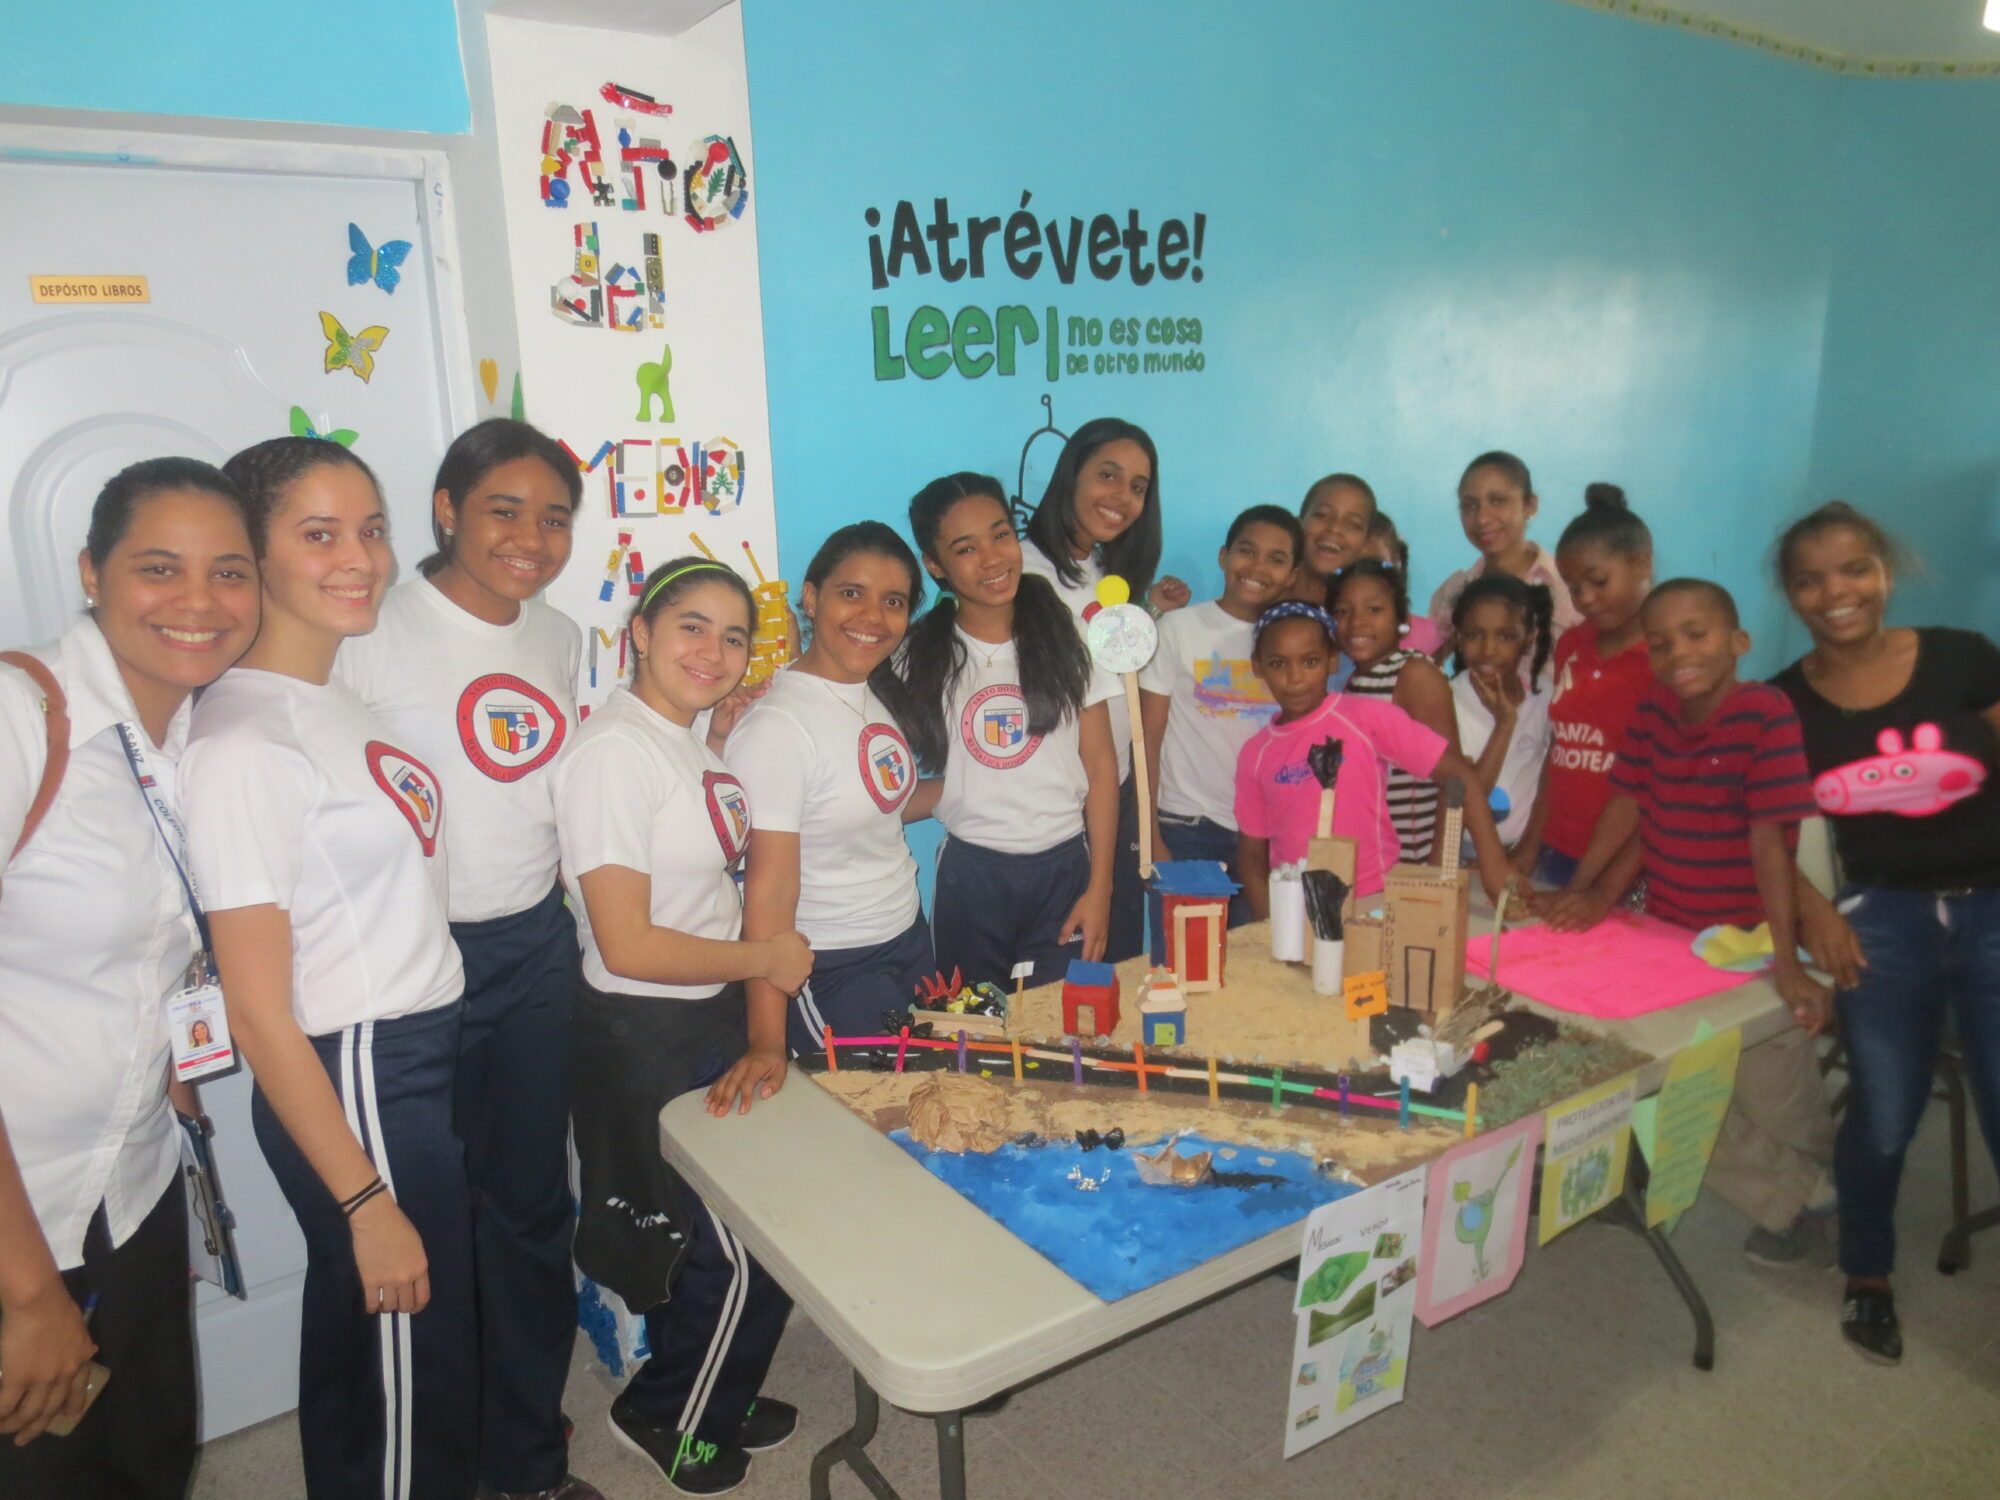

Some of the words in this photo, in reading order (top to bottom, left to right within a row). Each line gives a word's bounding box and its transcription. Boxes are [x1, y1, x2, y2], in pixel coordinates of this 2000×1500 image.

[864, 190, 1207, 290] ¡Atrévete!
[39, 282, 97, 296] DEPÓSITO
[102, 284, 142, 297] LIBROS
[1110, 316, 1140, 346] es
[1146, 316, 1203, 346] cosa
[1144, 348, 1206, 373] mundo
[468, 676, 498, 697] SANTO
[500, 677, 545, 699] DOMINGO
[972, 686, 996, 705] SANTO
